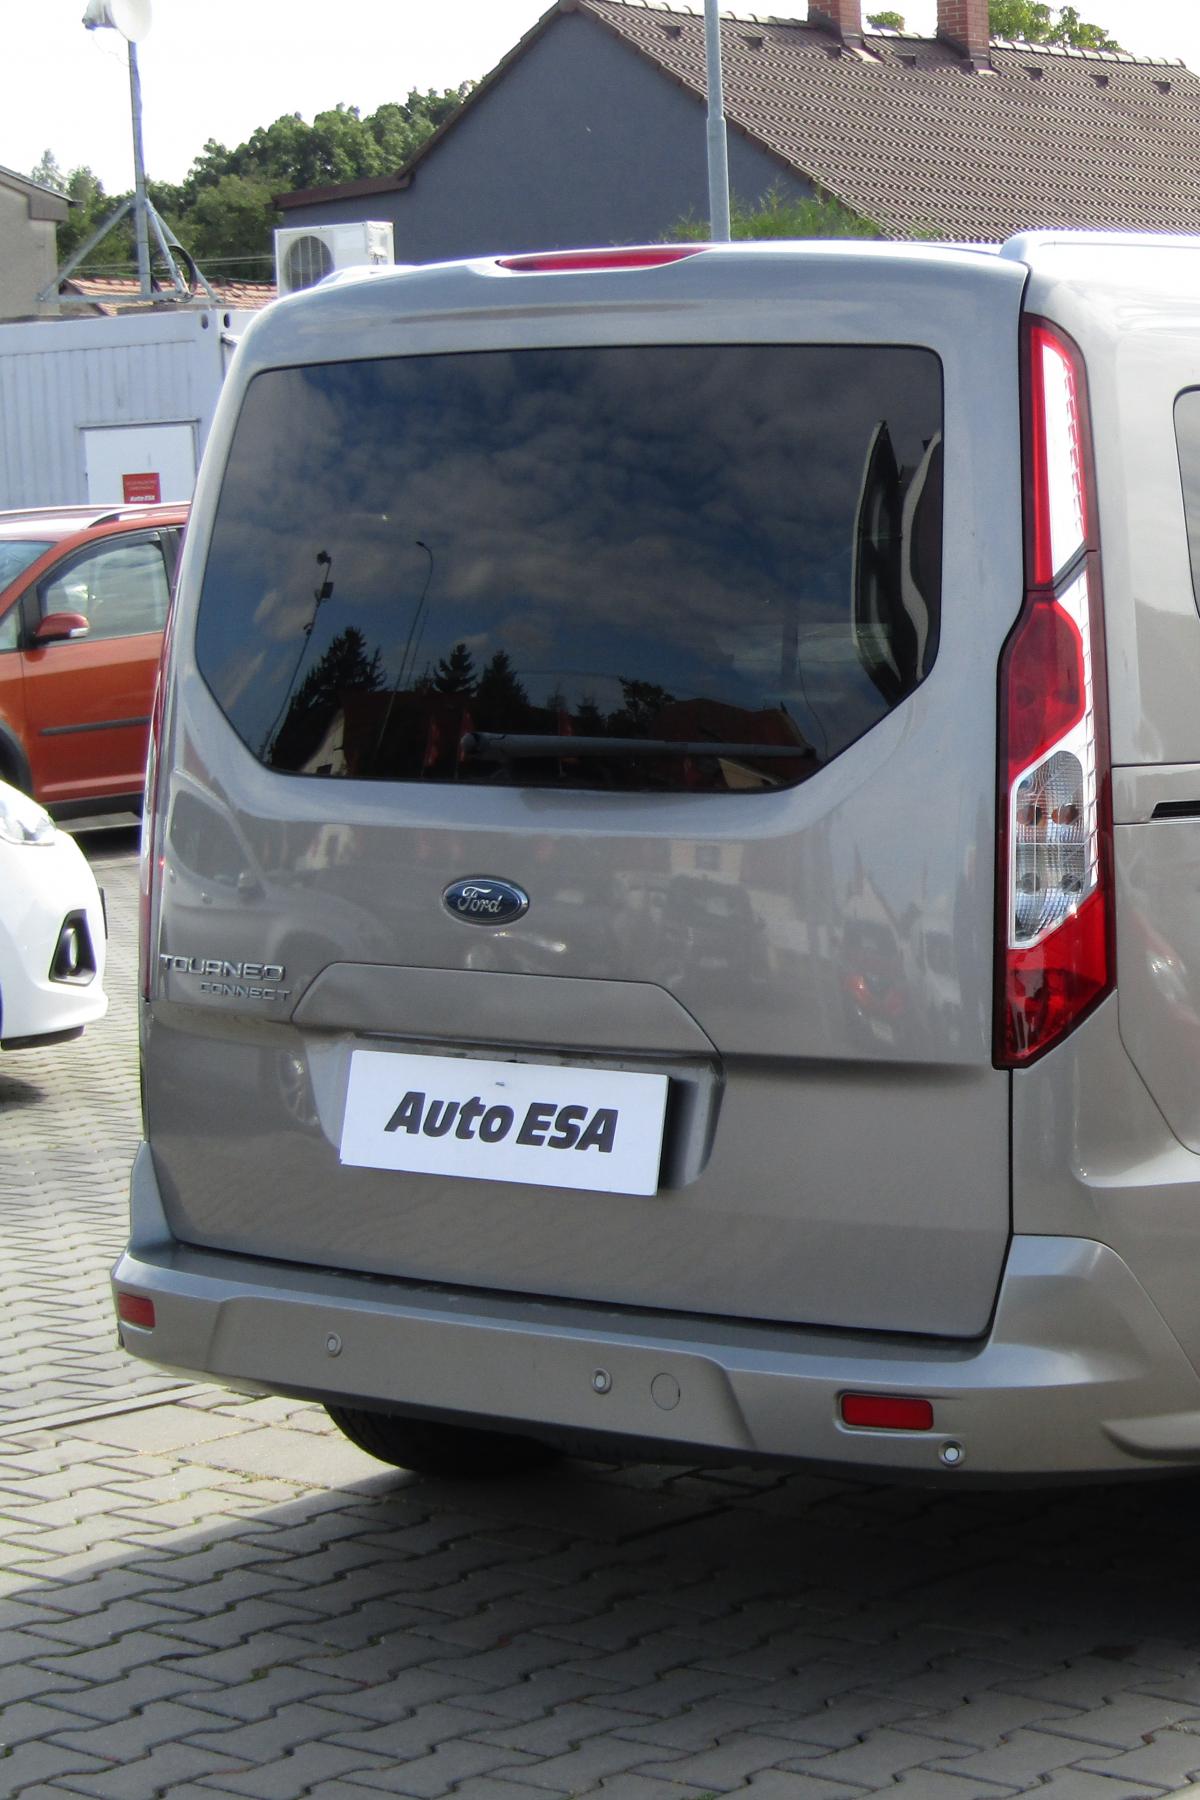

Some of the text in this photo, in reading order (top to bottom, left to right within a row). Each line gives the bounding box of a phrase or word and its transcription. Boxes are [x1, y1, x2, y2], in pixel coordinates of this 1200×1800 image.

[457, 886, 503, 913] Ford
[160, 953, 284, 982] TOURNEO
[200, 981, 292, 1001] CONNECT
[384, 1091, 619, 1153] Auto ESA
